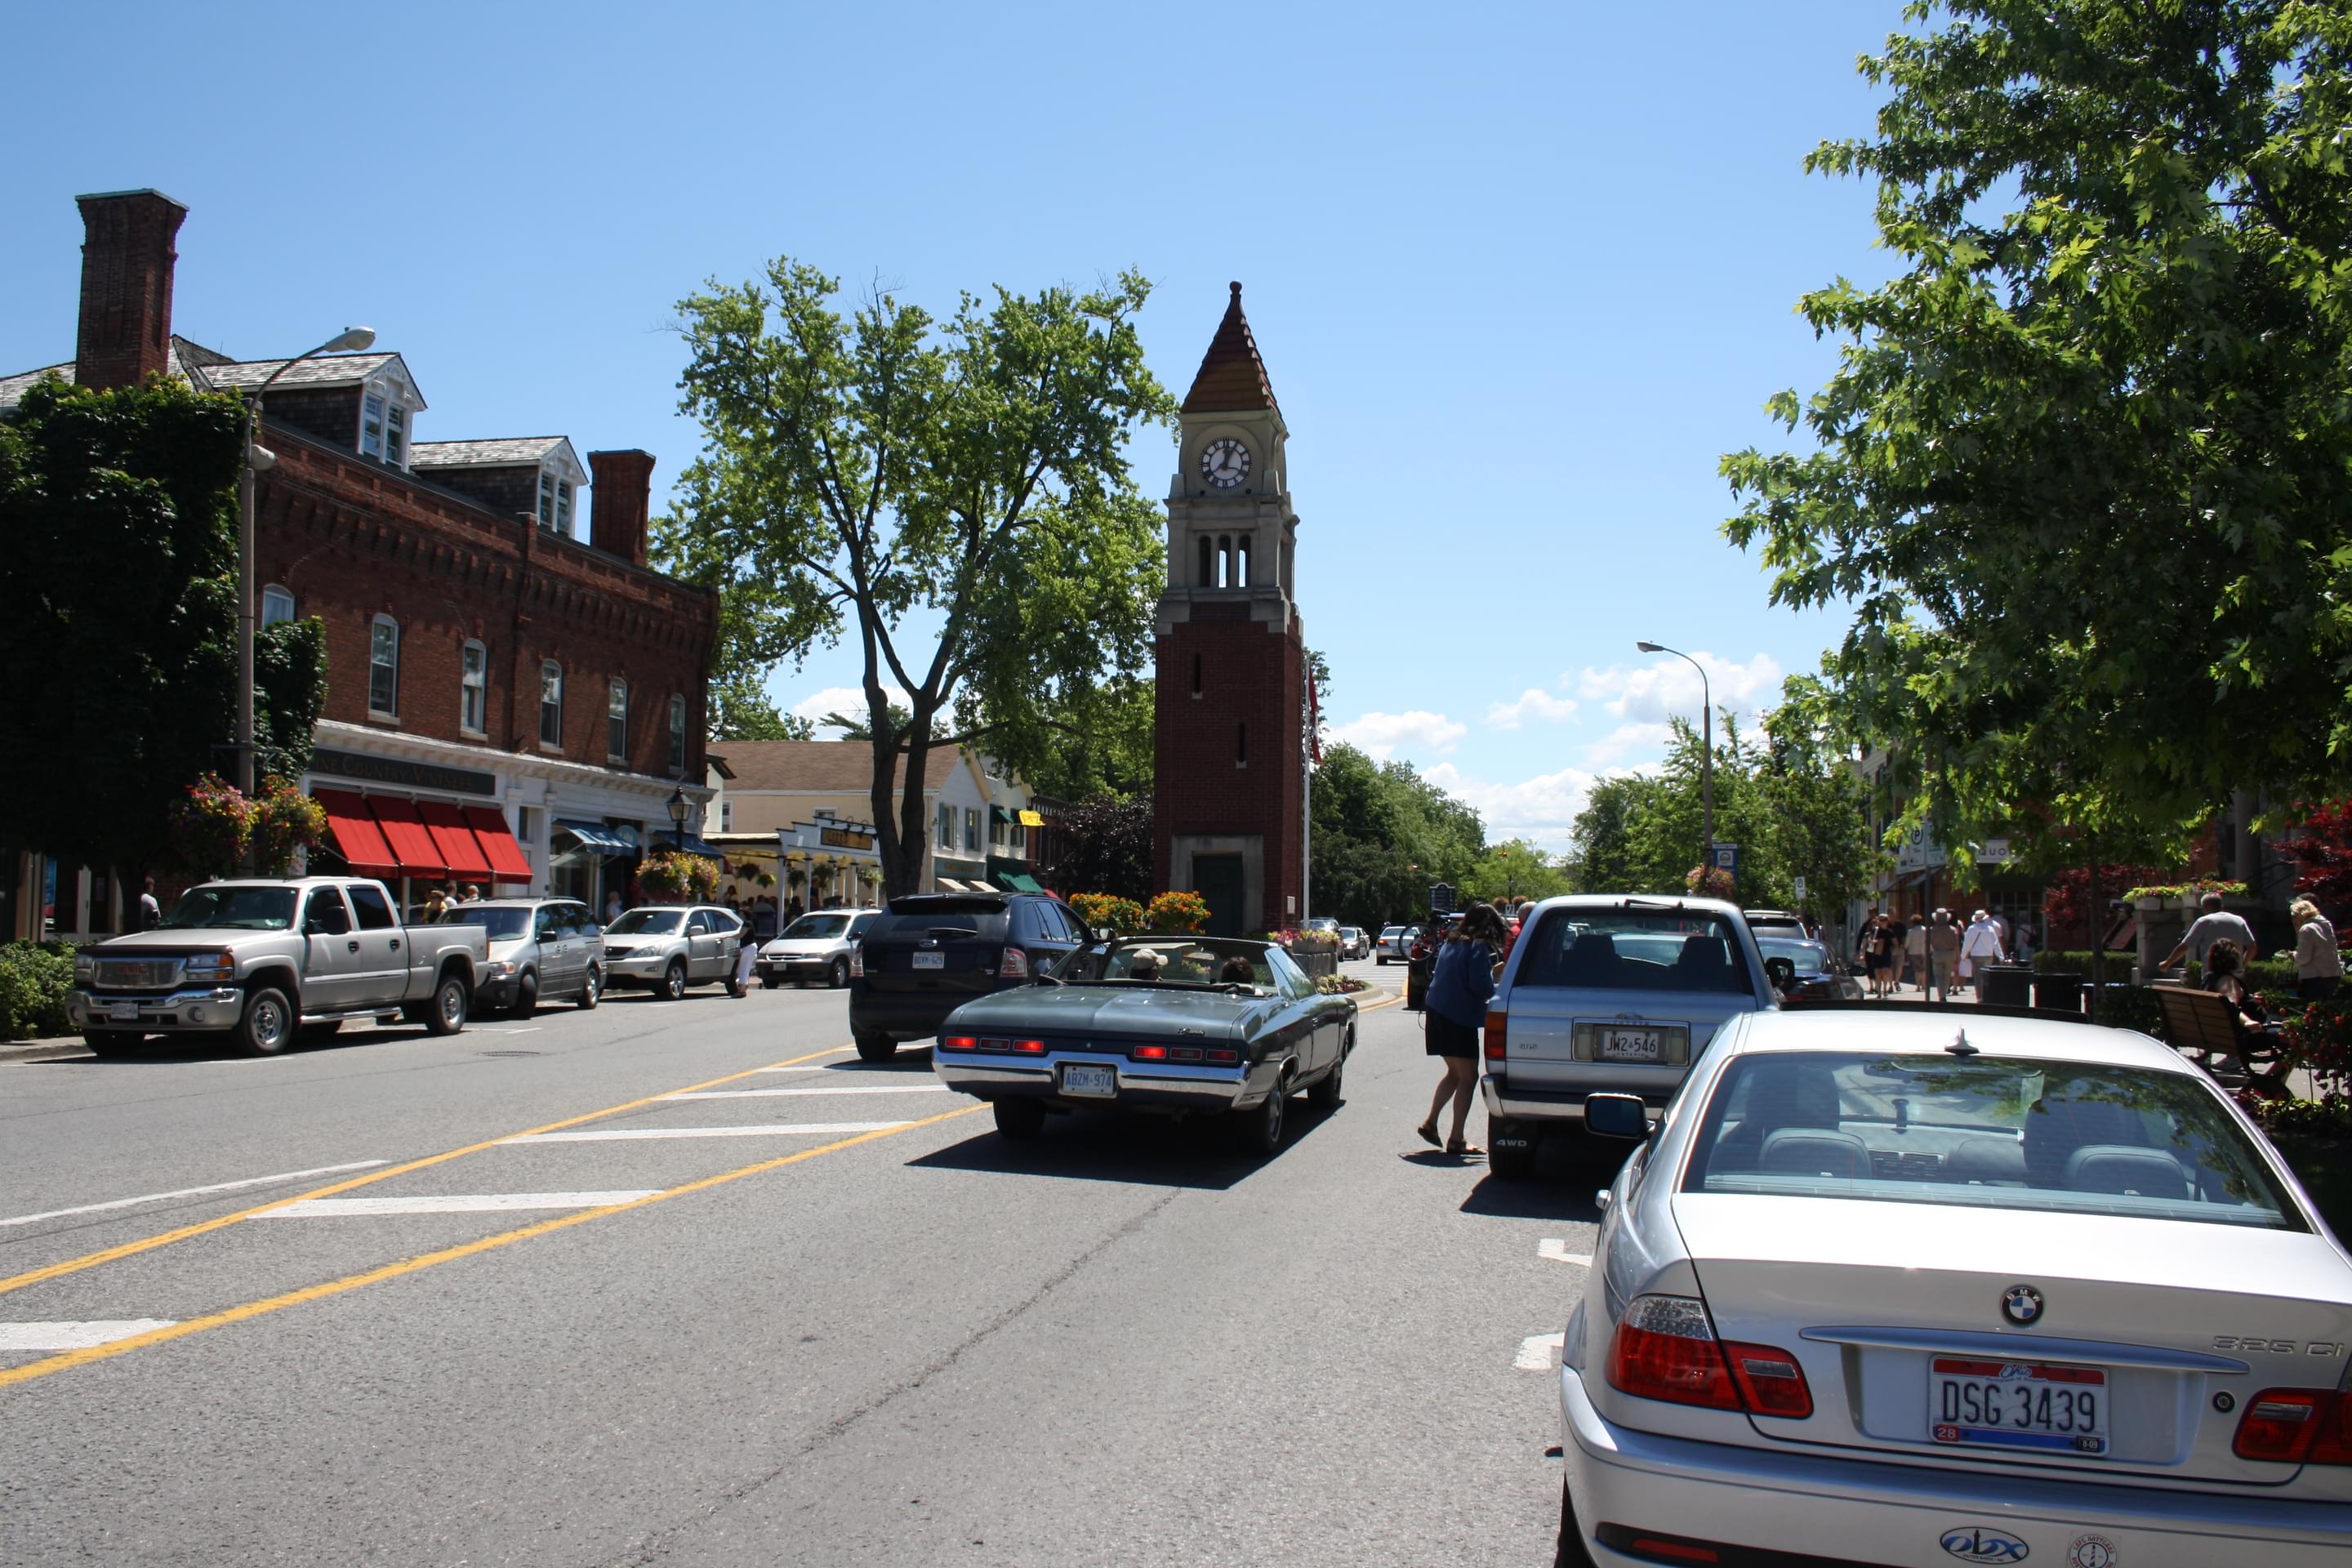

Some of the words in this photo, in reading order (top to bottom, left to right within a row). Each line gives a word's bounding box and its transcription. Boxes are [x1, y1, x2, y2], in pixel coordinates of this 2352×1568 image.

[315, 756, 338, 772] INE
[342, 755, 407, 782] COUNTRY
[1606, 1036, 1628, 1052] JW2
[1634, 1037, 1656, 1053] 546
[1066, 1072, 1089, 1086] ABZM
[1094, 1073, 1111, 1087] 974
[2006, 1289, 2041, 1302] BMW
[2212, 1335, 2296, 1355] 325
[2000, 1364, 2032, 1379] Ohio
[1943, 1380, 2001, 1425] DSG
[2014, 1386, 2096, 1432] 3439
[1937, 1428, 1956, 1438] 28
[2082, 1441, 2098, 1449] 8-09
